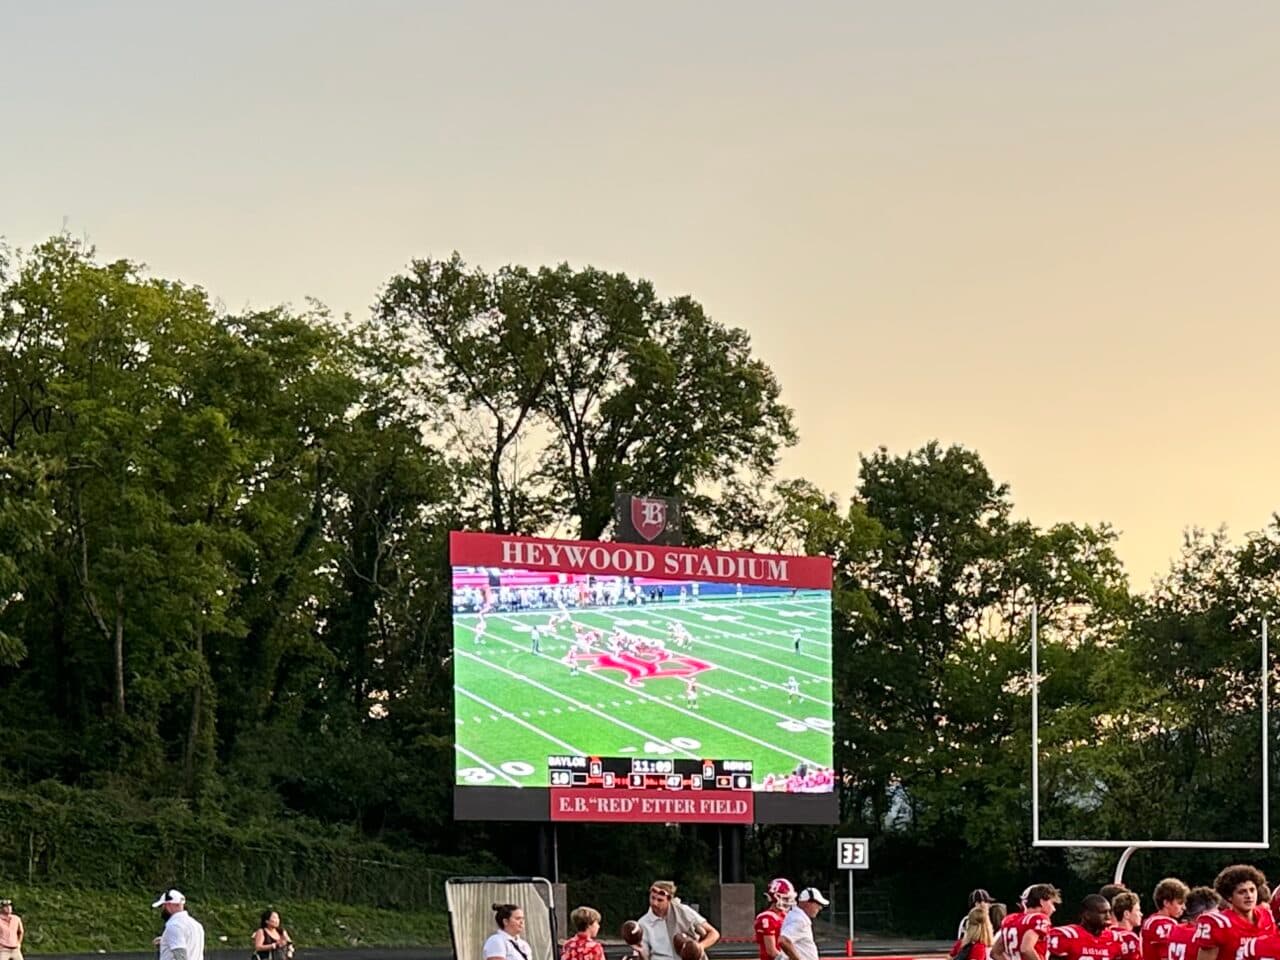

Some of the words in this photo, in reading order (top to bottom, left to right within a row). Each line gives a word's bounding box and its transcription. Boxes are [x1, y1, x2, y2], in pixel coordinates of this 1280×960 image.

[642, 501, 663, 527] B
[501, 541, 655, 573] HEYWOOD
[664, 552, 790, 582] STADIUM
[548, 756, 586, 768] BAYLOR
[559, 797, 589, 813] E.B.
[641, 801, 696, 814] ETTER
[700, 801, 748, 814] FIELD
[842, 843, 864, 864] 33
[1156, 923, 1172, 938] 47
